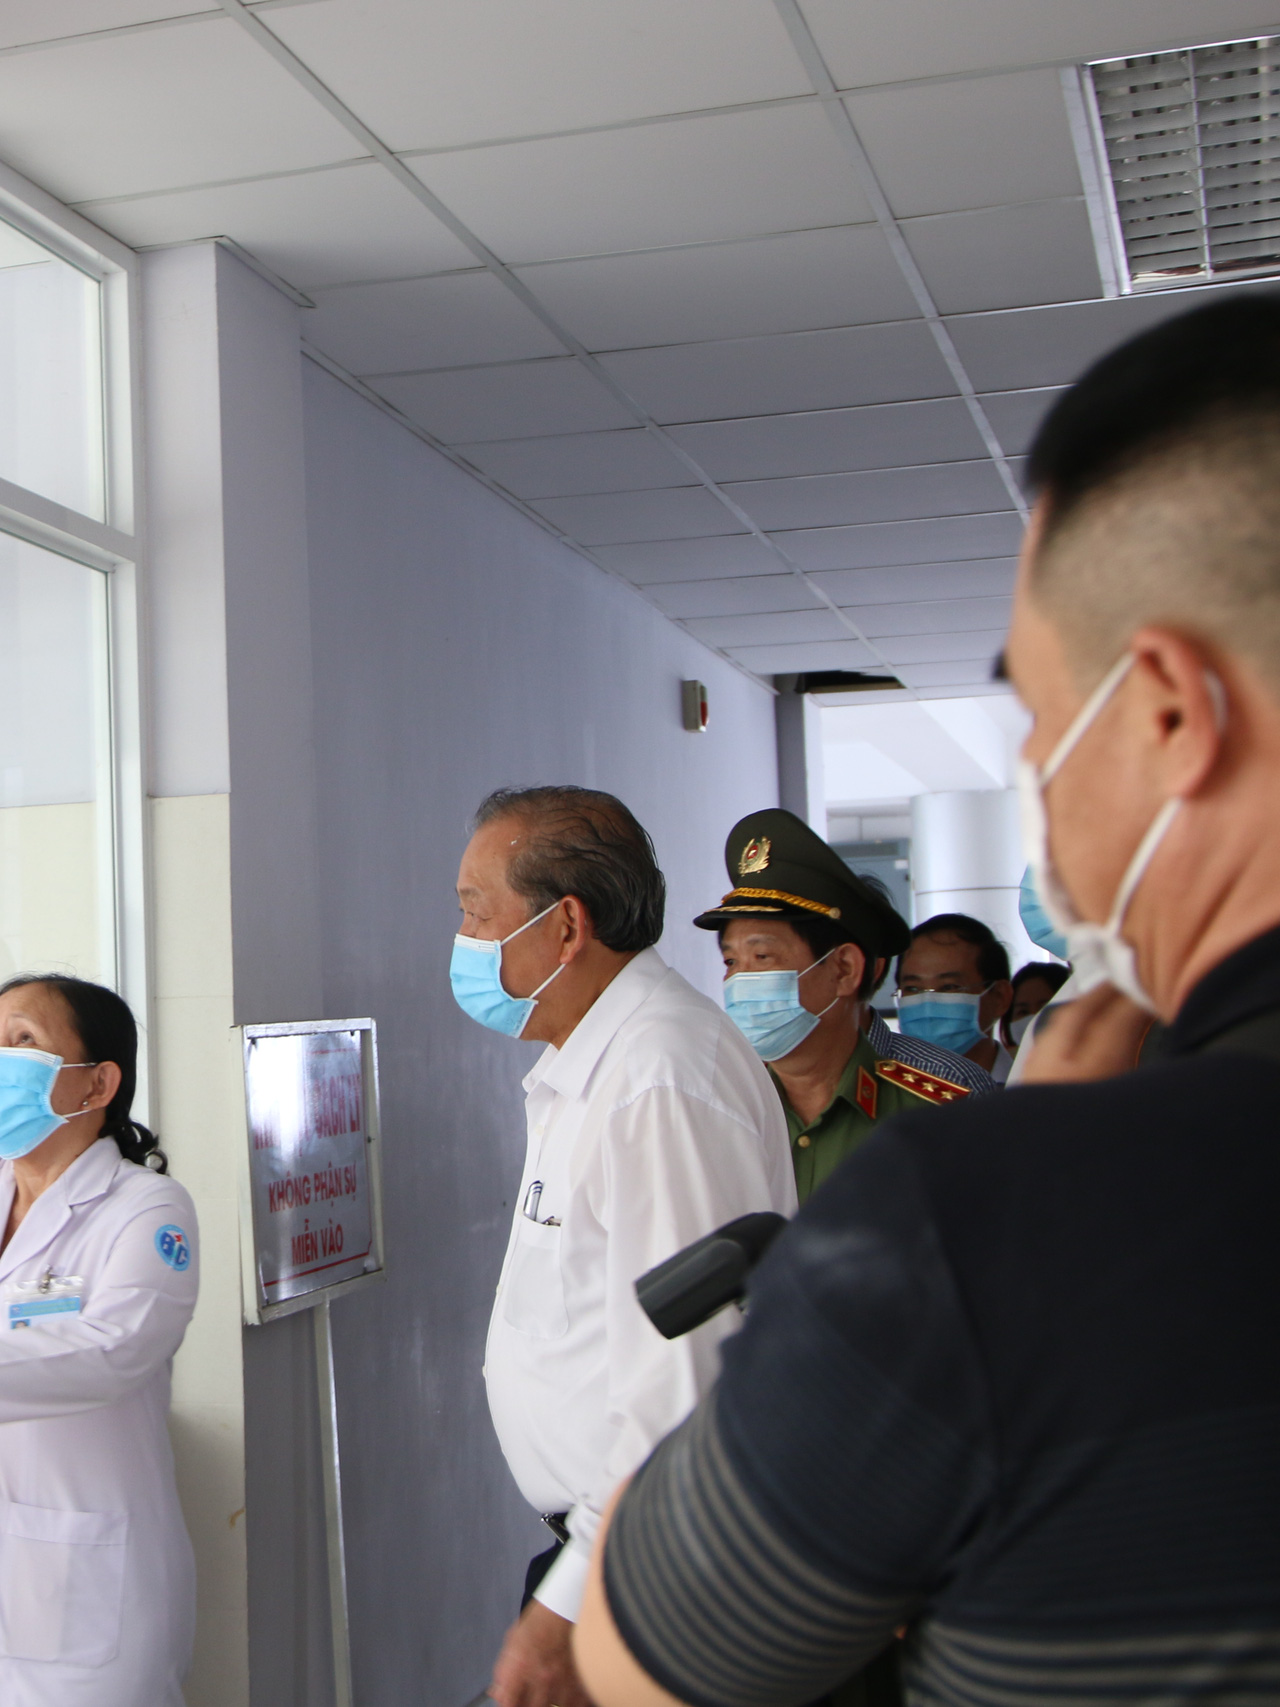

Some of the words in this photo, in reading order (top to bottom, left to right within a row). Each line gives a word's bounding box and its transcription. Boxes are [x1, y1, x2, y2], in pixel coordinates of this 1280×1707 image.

[268, 1170, 311, 1213] KHÔNG
[313, 1160, 343, 1207] PHẬN
[291, 1218, 319, 1267] MIỄN
[320, 1218, 344, 1258] VÀO
